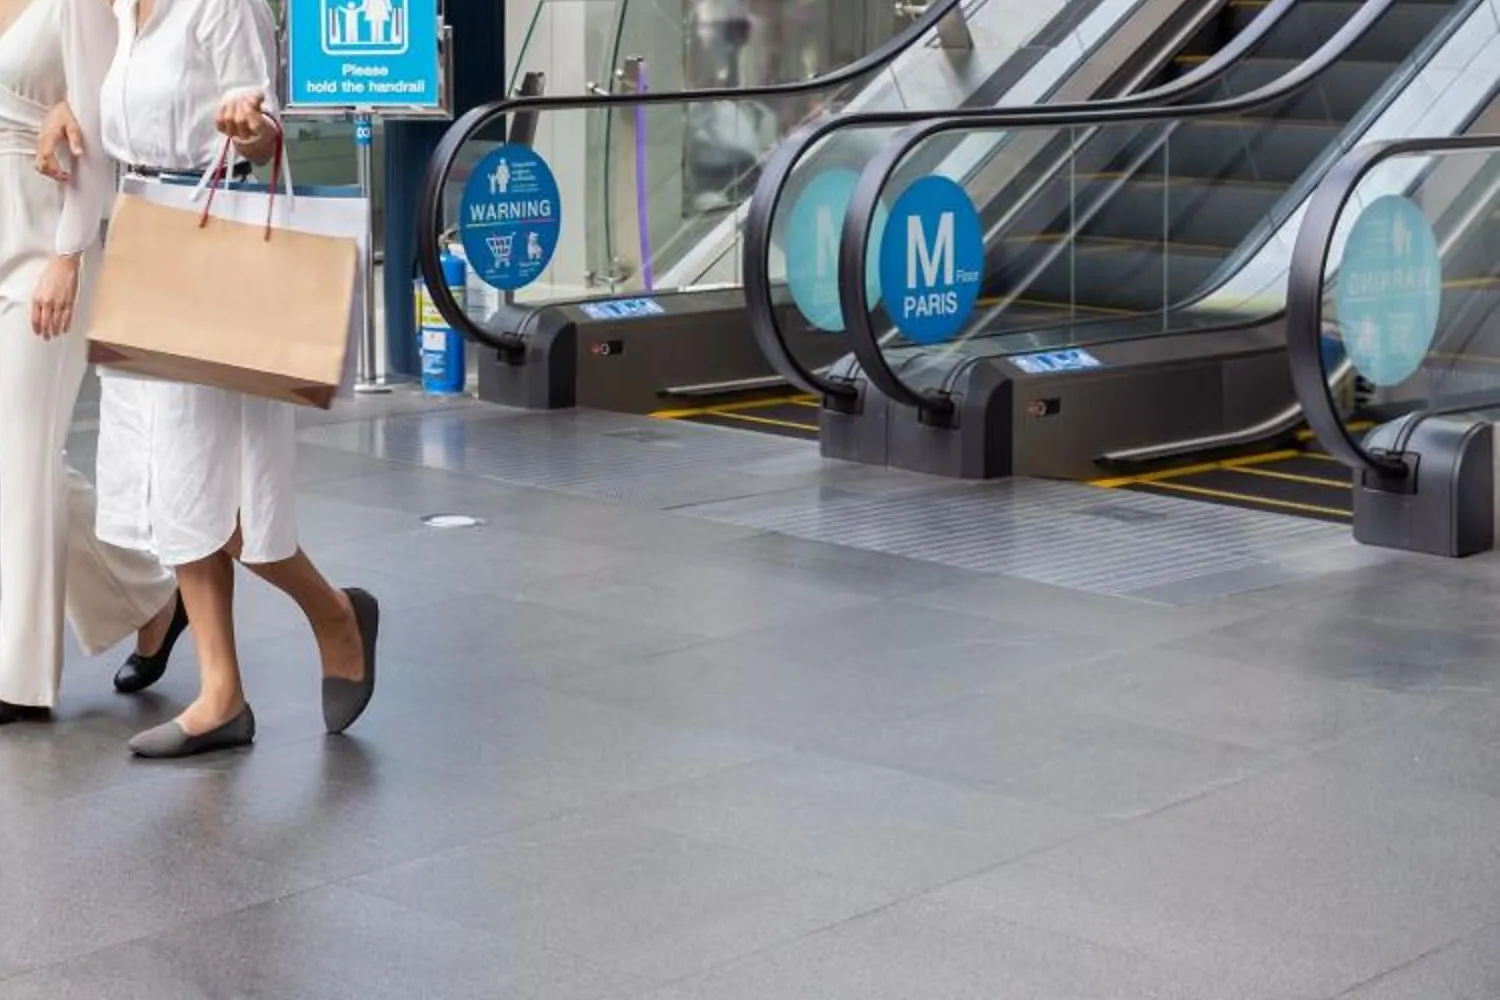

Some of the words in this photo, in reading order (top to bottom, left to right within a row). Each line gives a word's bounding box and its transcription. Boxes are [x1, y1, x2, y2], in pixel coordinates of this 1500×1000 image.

[342, 63, 388, 77] Please
[307, 80, 337, 93] hold
[342, 80, 364, 93] the
[368, 80, 425, 93] handrail
[469, 199, 551, 221] WARNING
[907, 211, 955, 289] M
[904, 291, 958, 319] PARIS
